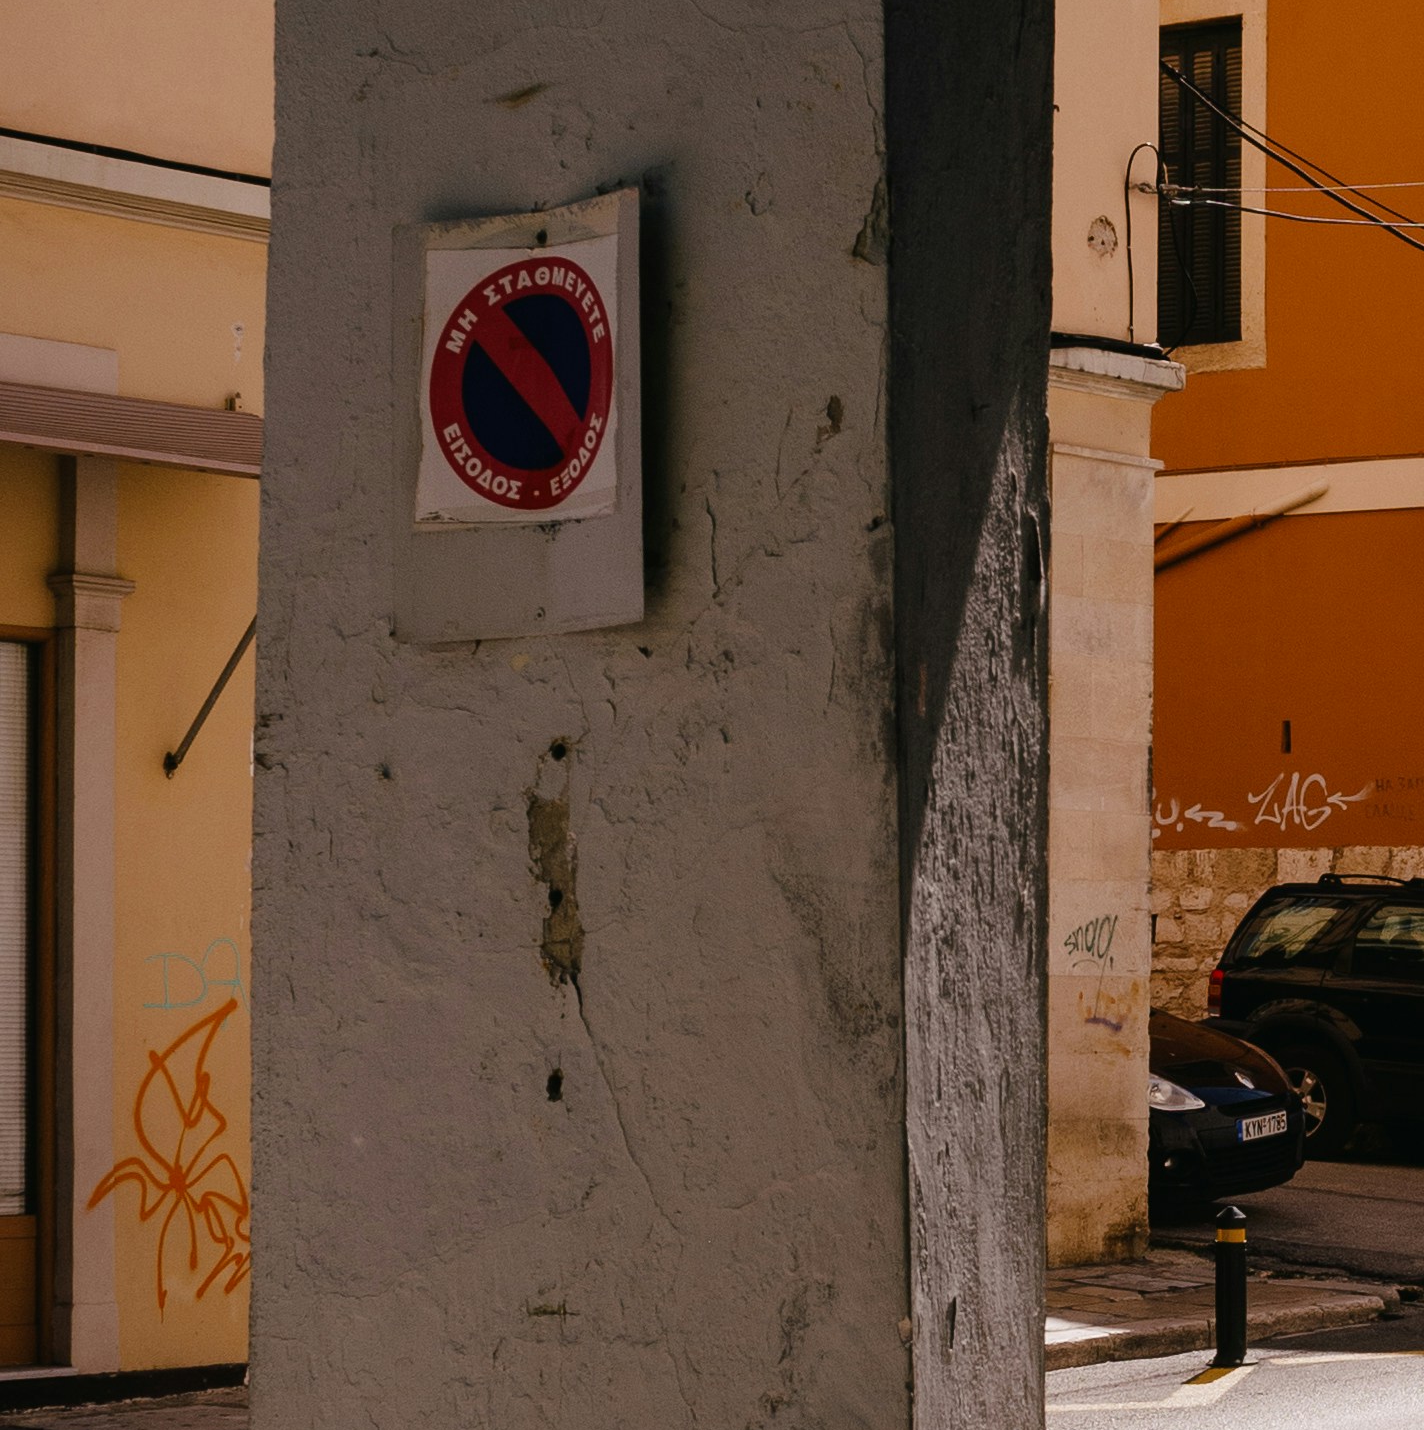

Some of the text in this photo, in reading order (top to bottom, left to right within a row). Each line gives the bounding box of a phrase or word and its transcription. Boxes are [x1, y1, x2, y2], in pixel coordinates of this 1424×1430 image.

[446, 266, 605, 354] ΜΗ ΣΤΑΘΜΕΥΕΤΕ
[443, 412, 603, 500] ΕΙΣΟΔΟΣ ΕΞΟΔΟΣ
